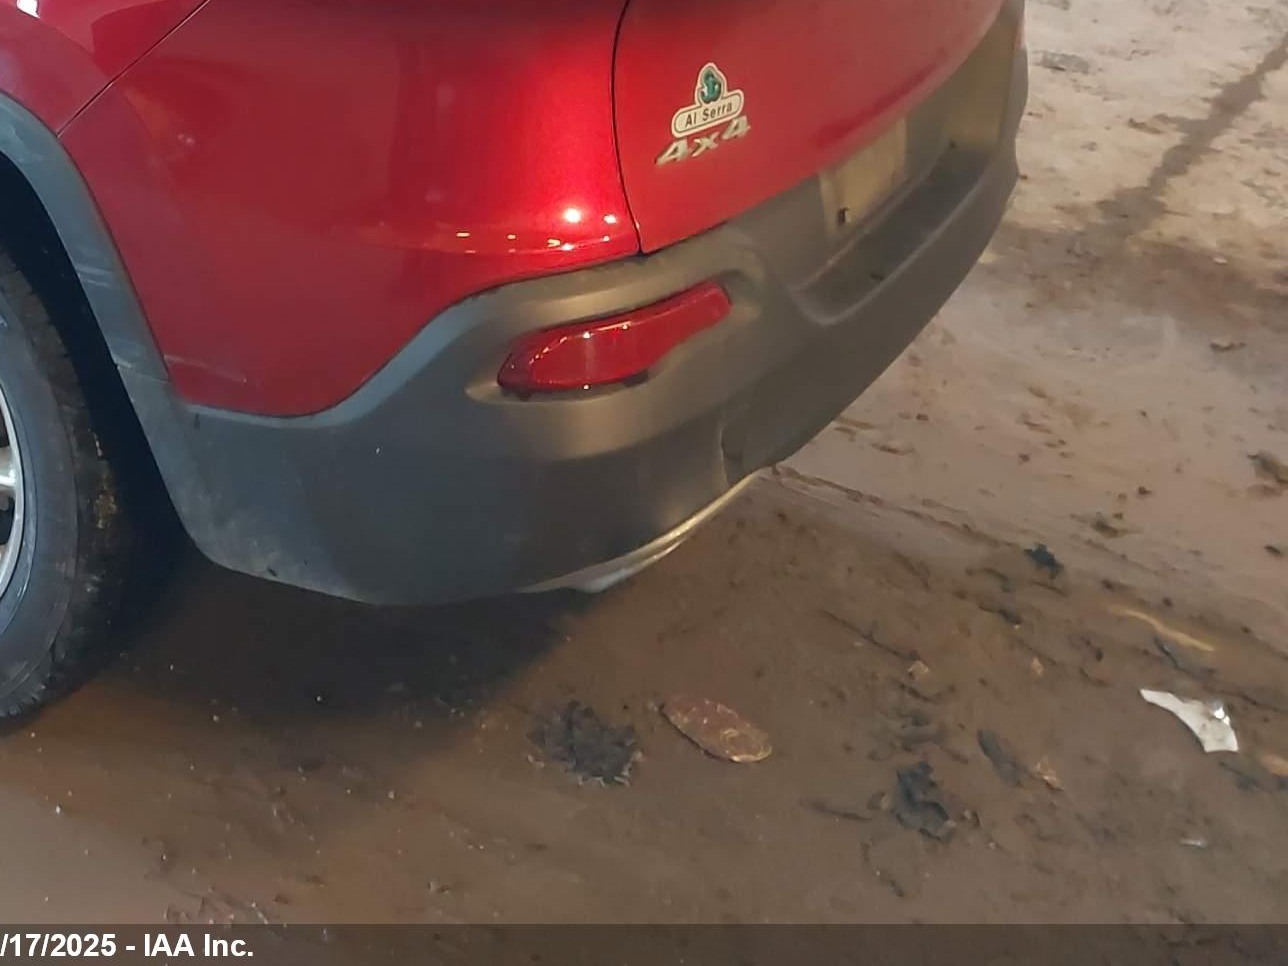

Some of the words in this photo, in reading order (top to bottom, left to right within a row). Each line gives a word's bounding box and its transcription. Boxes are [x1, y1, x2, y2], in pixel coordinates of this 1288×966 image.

[685, 112, 697, 129] Al
[702, 101, 733, 122] Serra
[655, 115, 751, 165] 4x4
